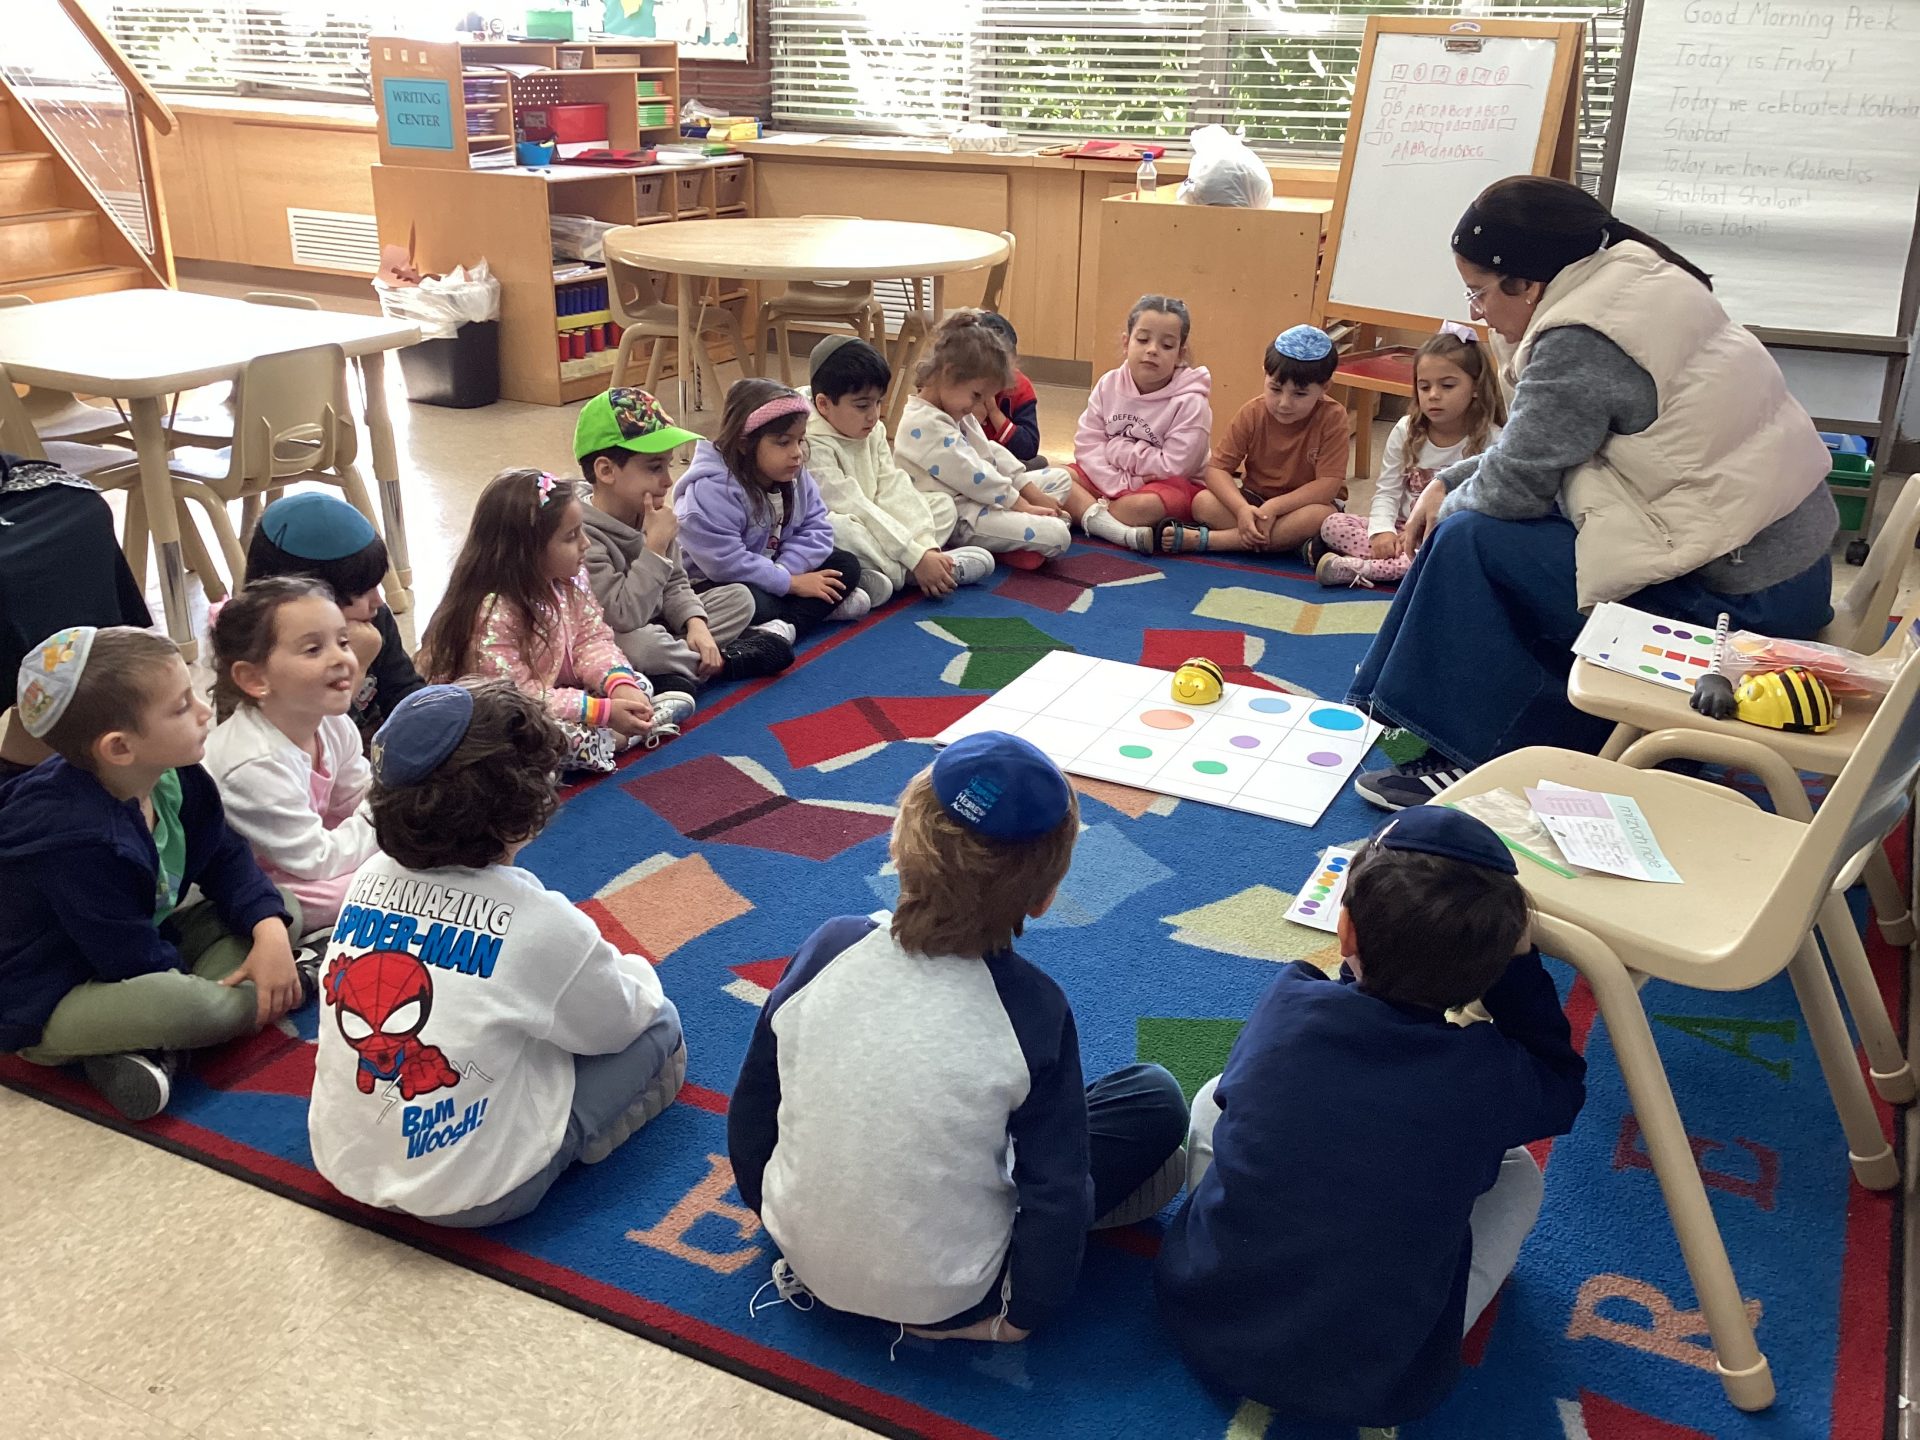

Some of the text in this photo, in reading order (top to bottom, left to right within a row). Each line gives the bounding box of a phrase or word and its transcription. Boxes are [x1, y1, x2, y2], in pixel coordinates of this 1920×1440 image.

[1684, 0, 1740, 26] Good
[1750, 0, 1834, 39] Morning
[1673, 43, 1735, 84] Today
[1748, 52, 1765, 69] is
[392, 90, 440, 105] WRITING
[397, 112, 440, 127] CENTER
[1113, 413, 1144, 425] DEFENE
[349, 872, 516, 936] THE AMAZING
[332, 903, 504, 979] SPIDER-MAN
[402, 1097, 455, 1138] BAM
[406, 1098, 489, 1160] WOOSH!
